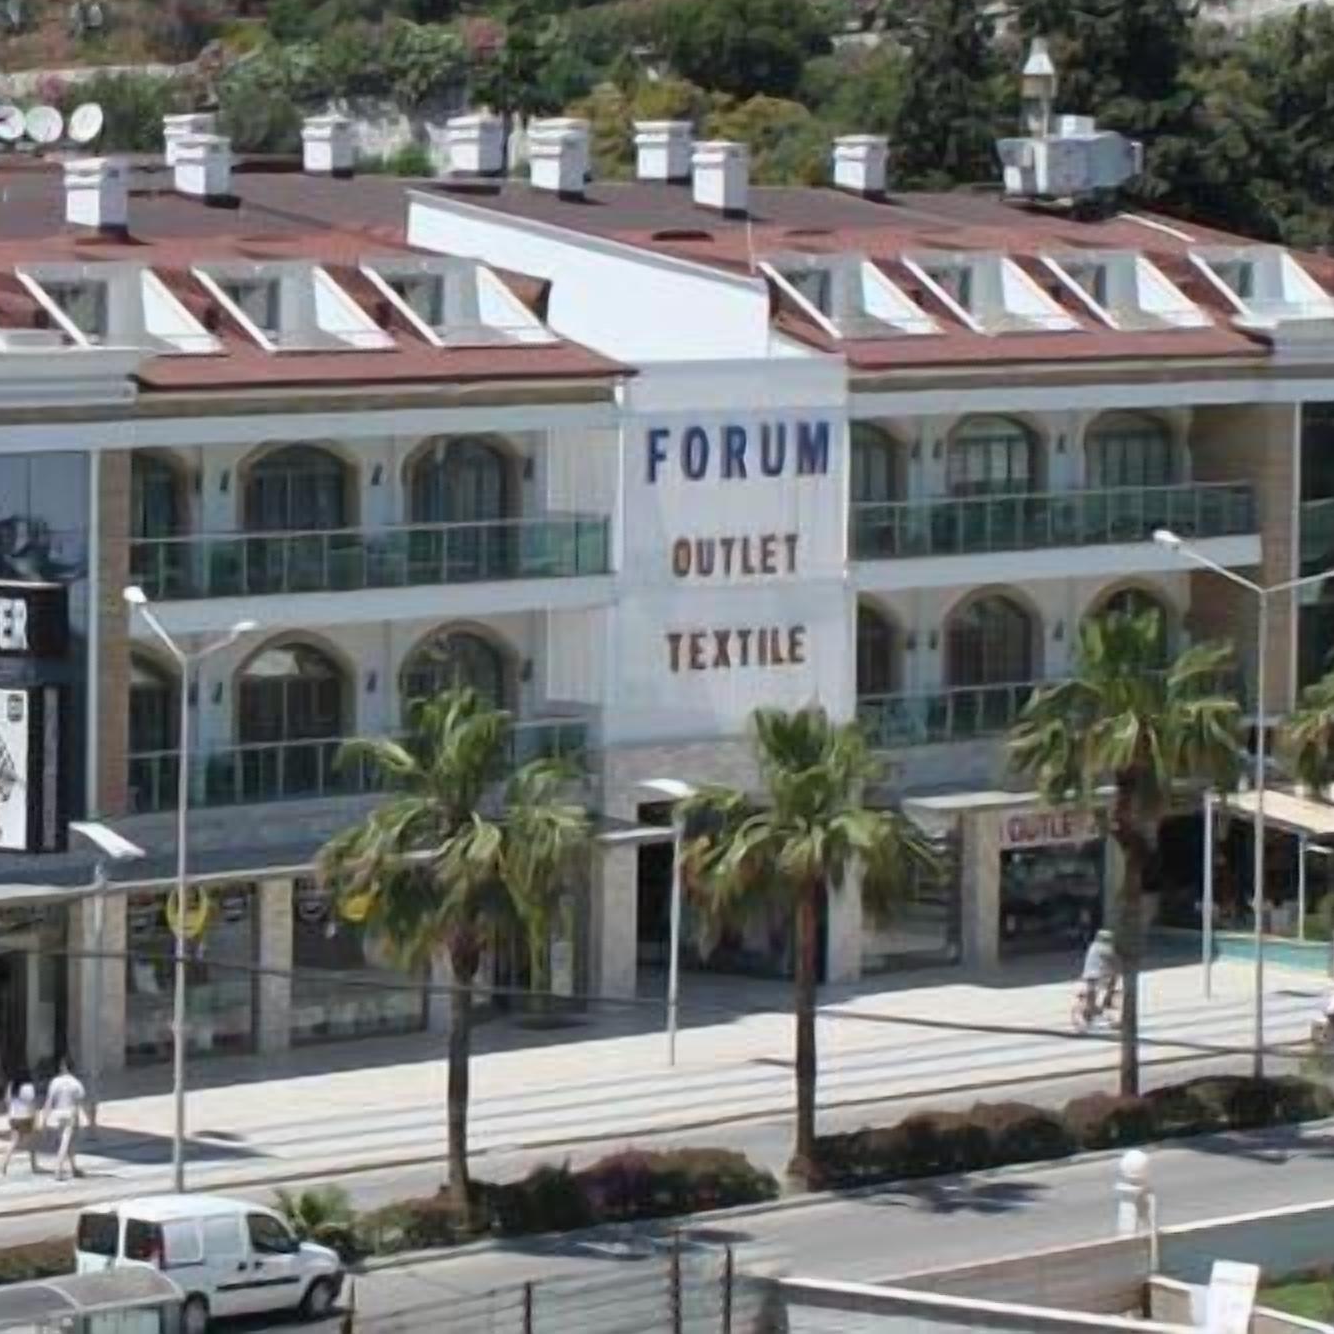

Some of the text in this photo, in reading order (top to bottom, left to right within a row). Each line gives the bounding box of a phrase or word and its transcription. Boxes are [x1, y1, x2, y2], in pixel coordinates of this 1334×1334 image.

[645, 421, 830, 484] FORUM
[672, 533, 799, 578] OUTLET
[666, 624, 807, 673] TEXTILE
